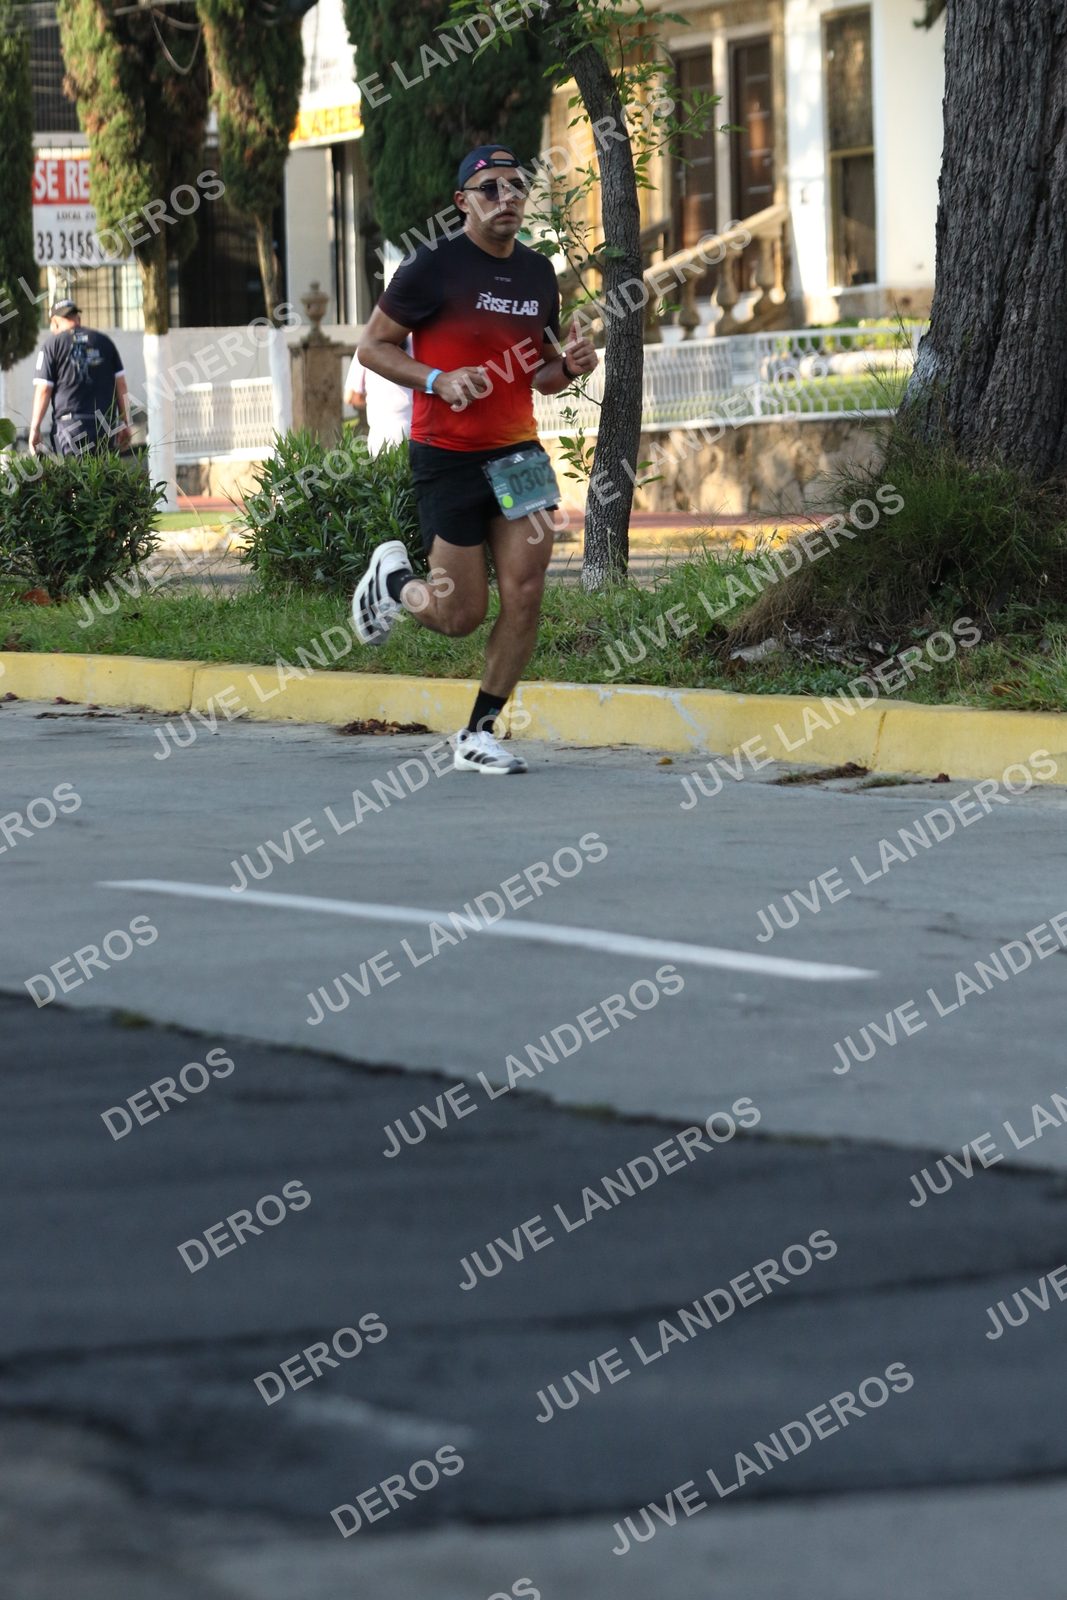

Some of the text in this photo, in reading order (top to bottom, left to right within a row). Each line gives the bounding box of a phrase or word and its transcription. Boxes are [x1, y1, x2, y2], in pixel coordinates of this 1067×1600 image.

[34, 160, 90, 200] SE RE
[37, 231, 53, 260] 33
[512, 299, 539, 316] LAB
